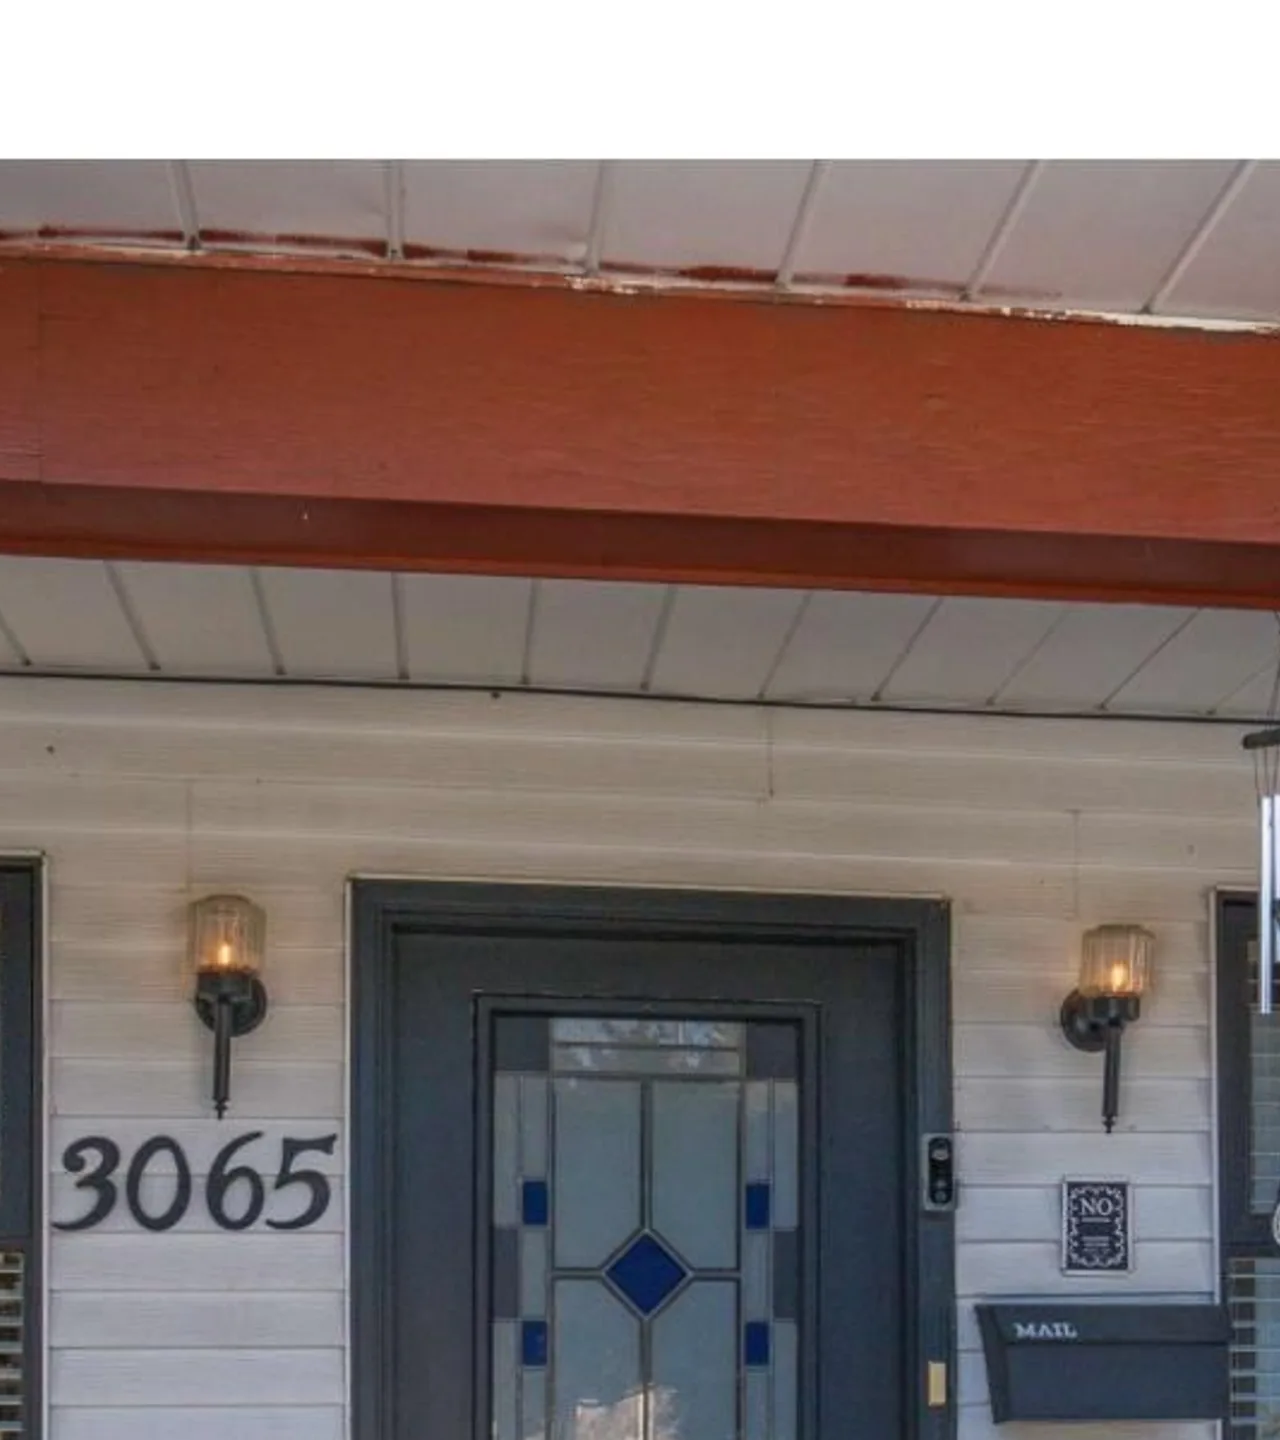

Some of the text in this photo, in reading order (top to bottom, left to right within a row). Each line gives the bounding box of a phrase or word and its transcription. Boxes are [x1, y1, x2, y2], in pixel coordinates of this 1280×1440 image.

[51, 1131, 337, 1231] 3065
[1080, 1197, 1113, 1216] NO
[1013, 1322, 1078, 1339] MAIL
